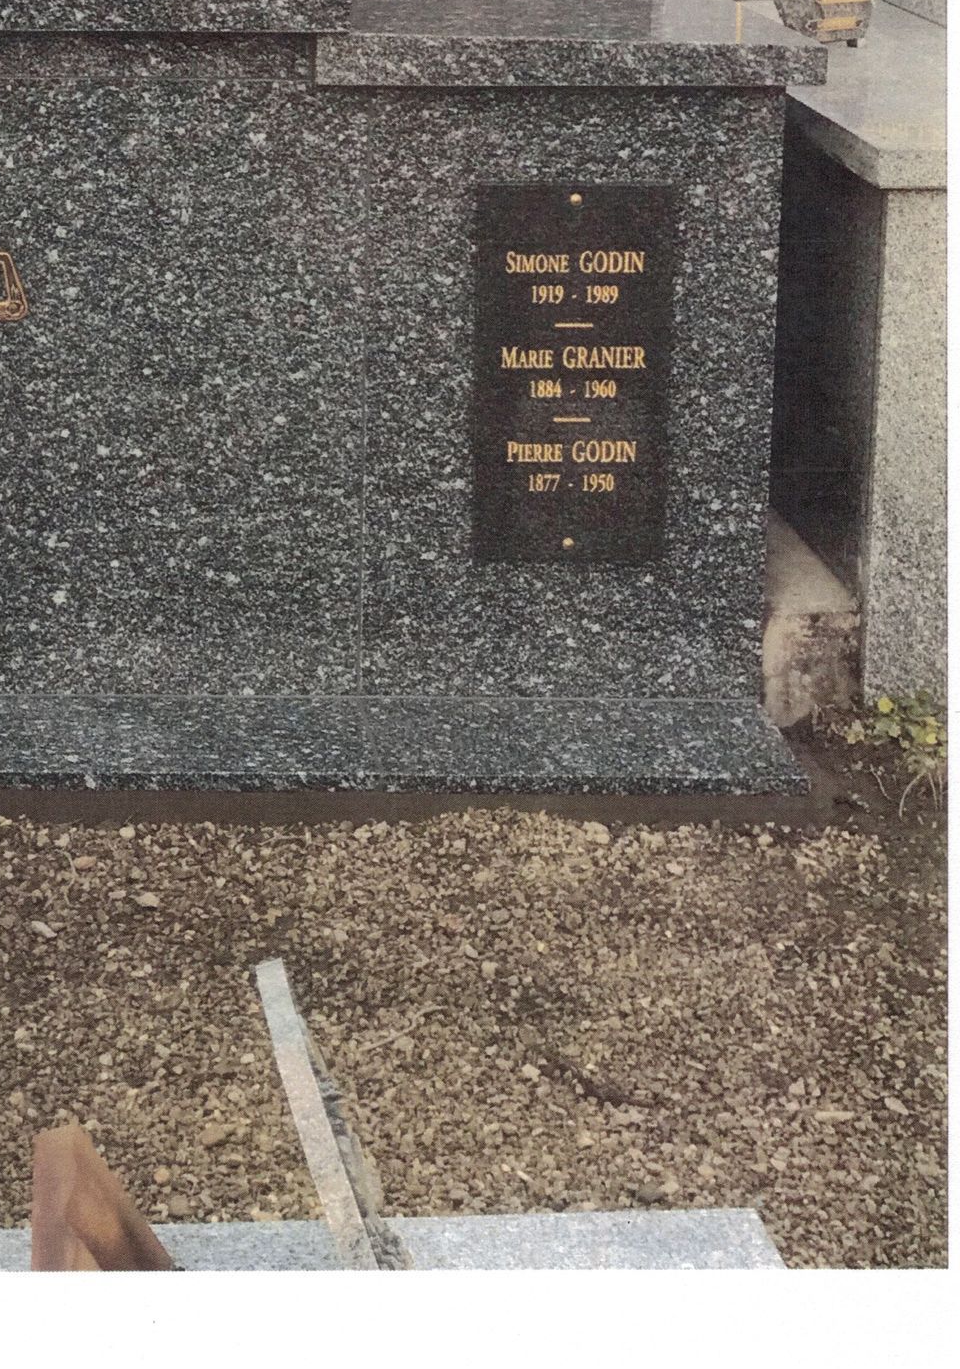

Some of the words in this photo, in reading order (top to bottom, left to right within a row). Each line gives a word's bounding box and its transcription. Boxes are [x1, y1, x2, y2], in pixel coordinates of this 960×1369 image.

[579, 250, 646, 274] GODIN
[531, 285, 564, 304] 1919
[586, 285, 619, 304] 1989
[562, 346, 646, 369] GRANIER
[529, 379, 562, 398] 1884
[584, 379, 616, 398] 1960
[572, 440, 637, 463] GODIN
[528, 473, 561, 492] 1877
[582, 473, 614, 492] 1950
